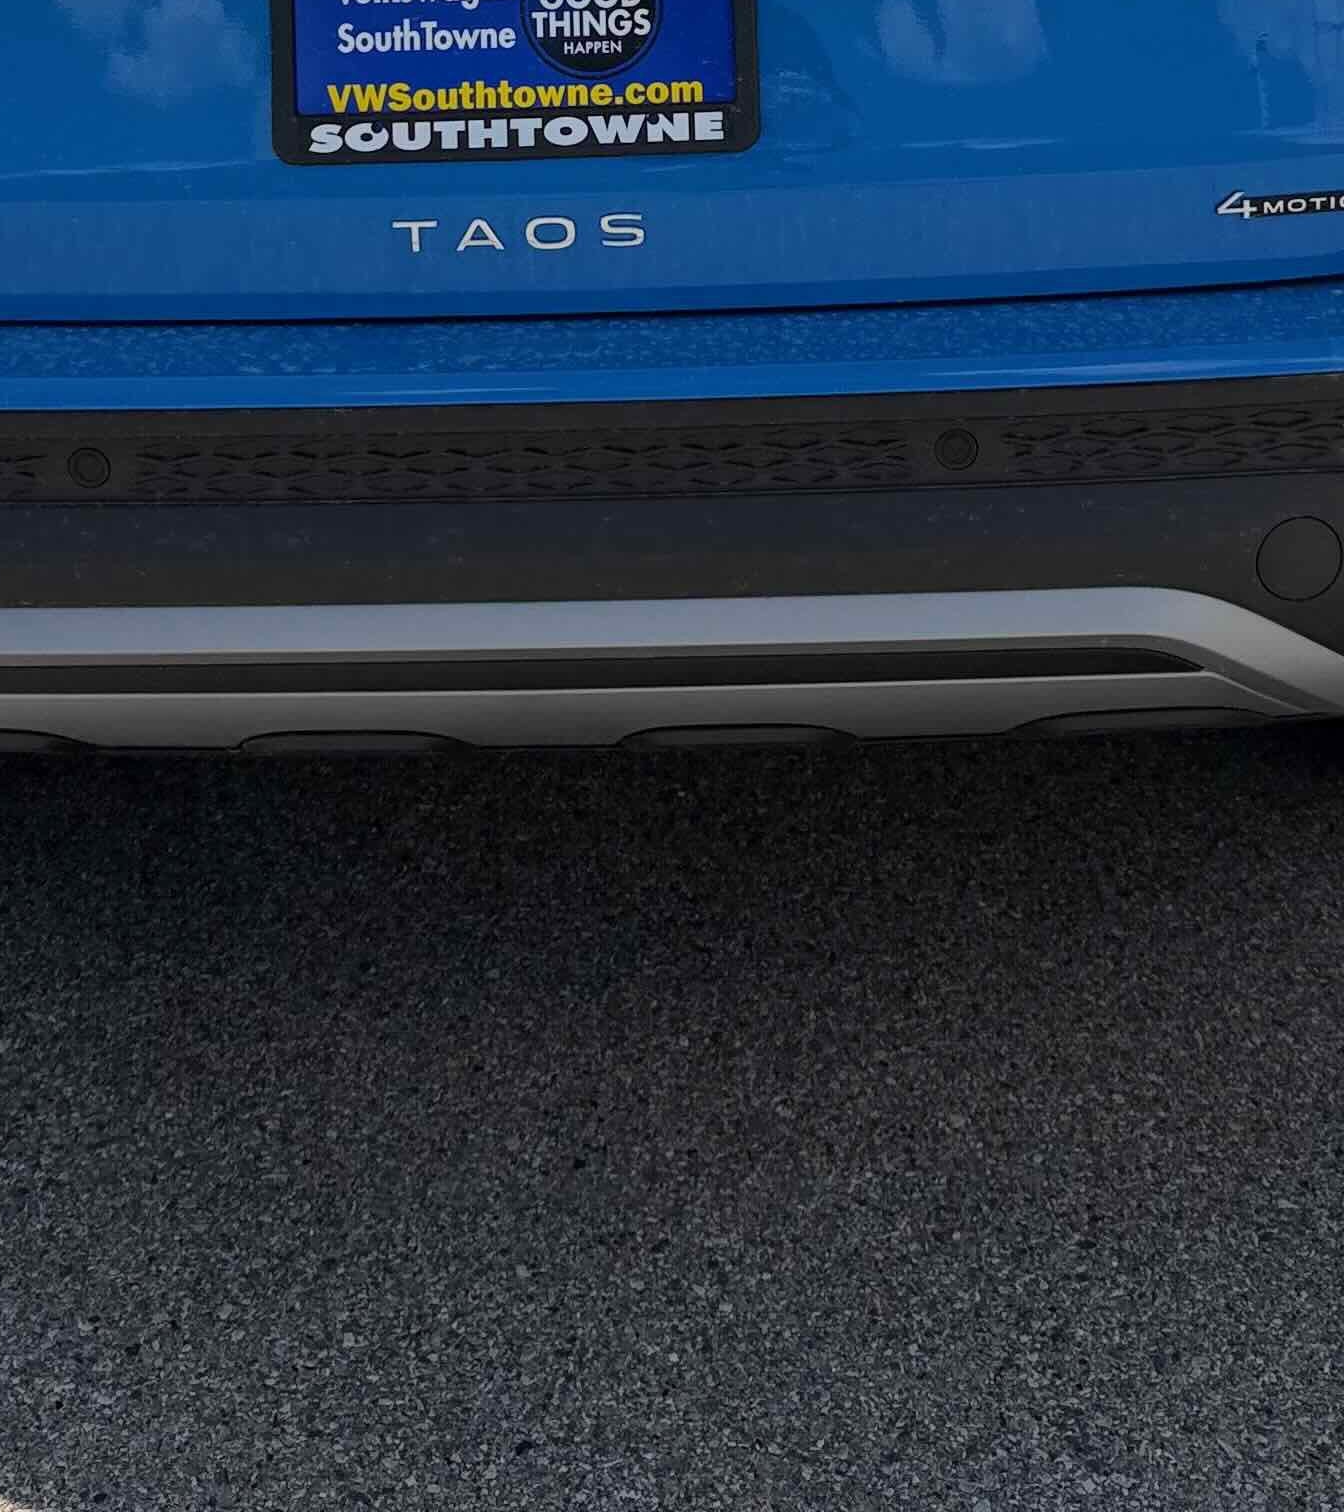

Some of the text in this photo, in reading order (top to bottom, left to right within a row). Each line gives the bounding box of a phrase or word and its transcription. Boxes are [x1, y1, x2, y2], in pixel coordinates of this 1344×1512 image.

[337, 18, 517, 54] SouthTowne
[531, 8, 651, 38] THINGS
[563, 40, 623, 55] HAPPEN
[327, 81, 704, 113] VWSouthtowne.com
[308, 111, 725, 154] SOUTHTOWNE
[391, 213, 646, 253] TAOS
